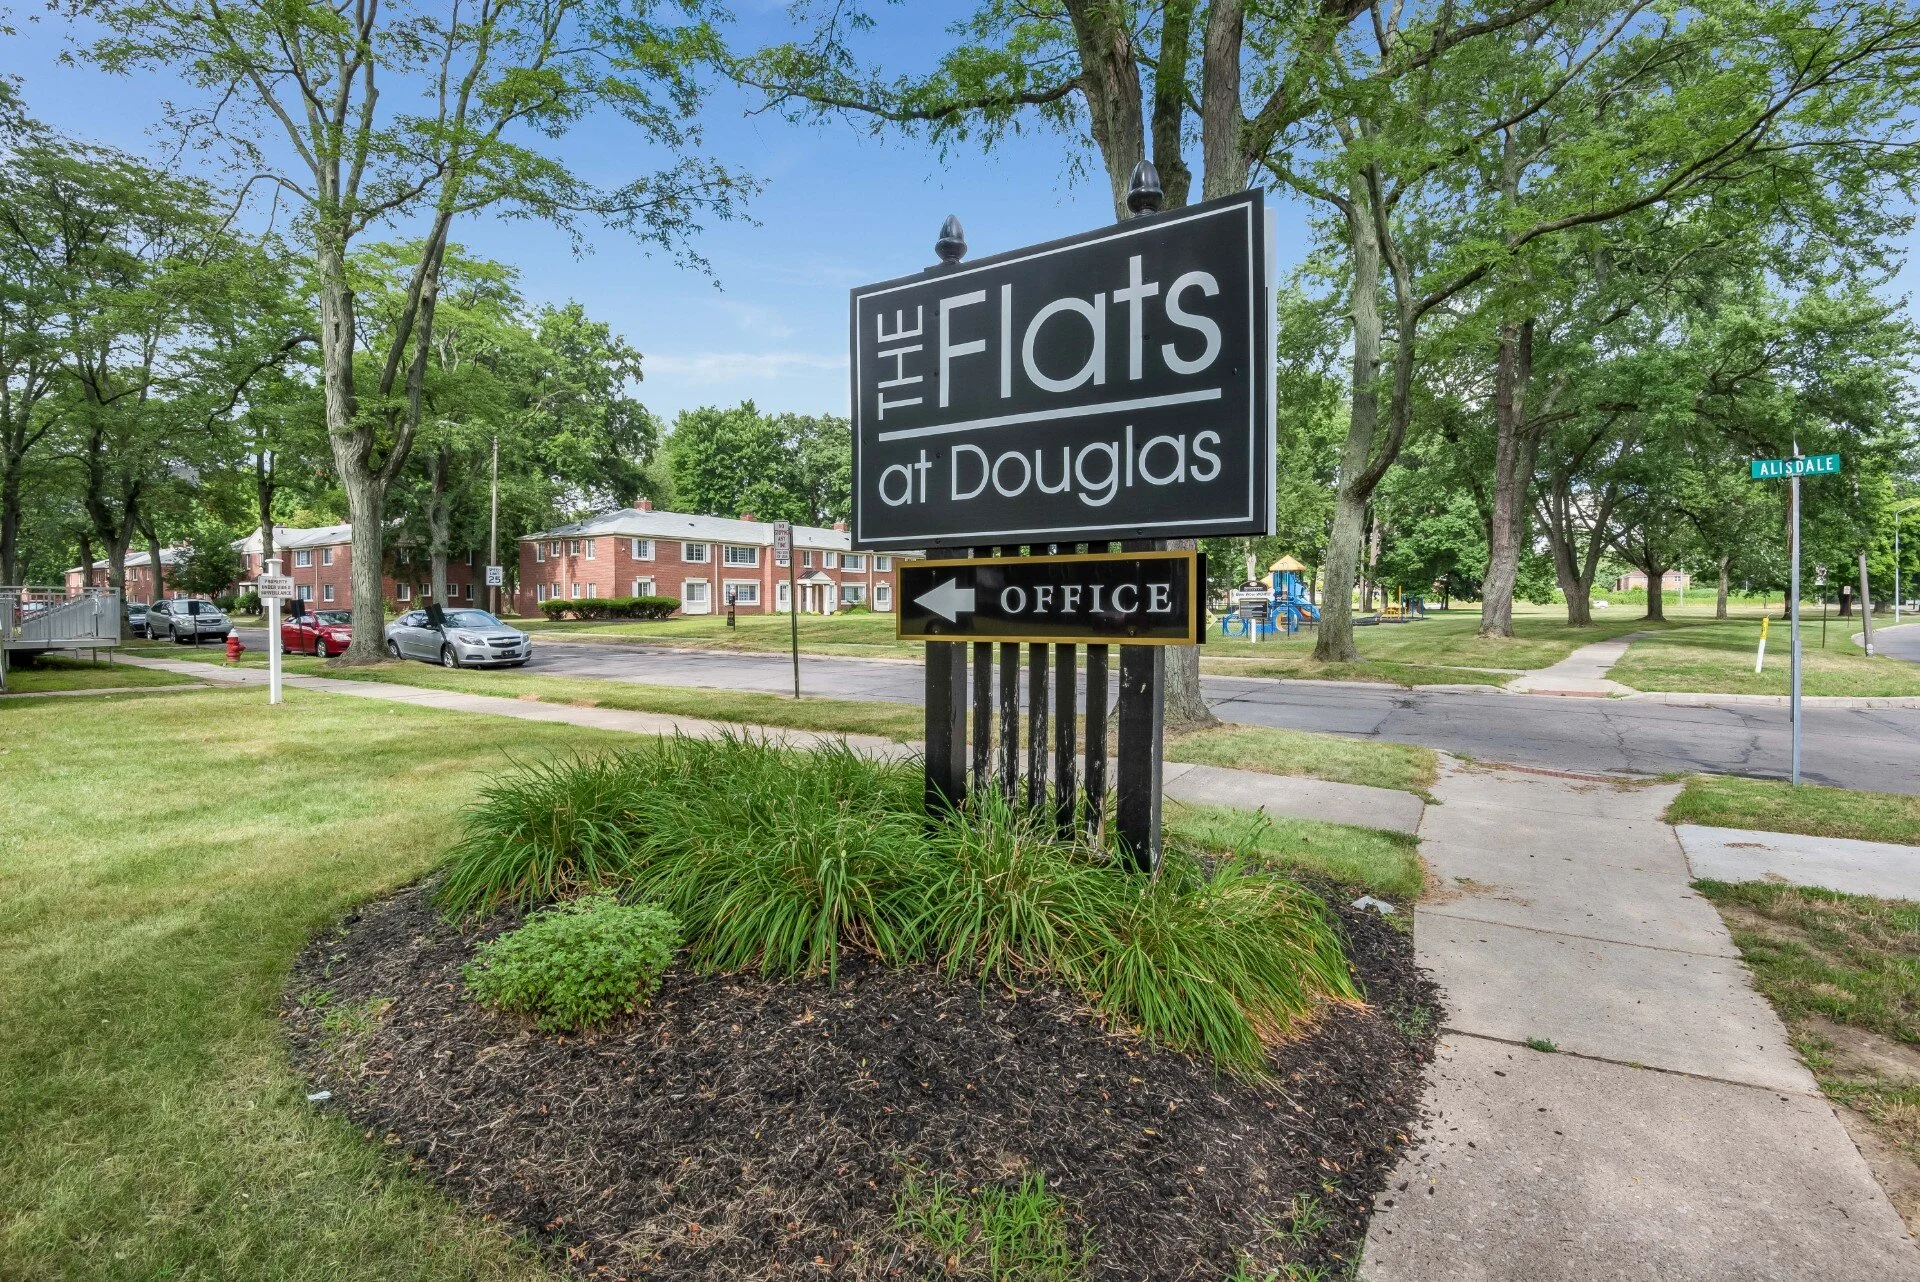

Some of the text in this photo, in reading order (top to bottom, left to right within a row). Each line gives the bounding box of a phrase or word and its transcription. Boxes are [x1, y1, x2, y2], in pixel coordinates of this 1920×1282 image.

[939, 255, 1222, 408] Flats
[877, 305, 923, 421] THE
[878, 425, 1222, 507] at Douglas
[1760, 457, 1834, 476] ALISDALE
[488, 575, 501, 583] 25
[1000, 583, 1172, 614] OFFICE
